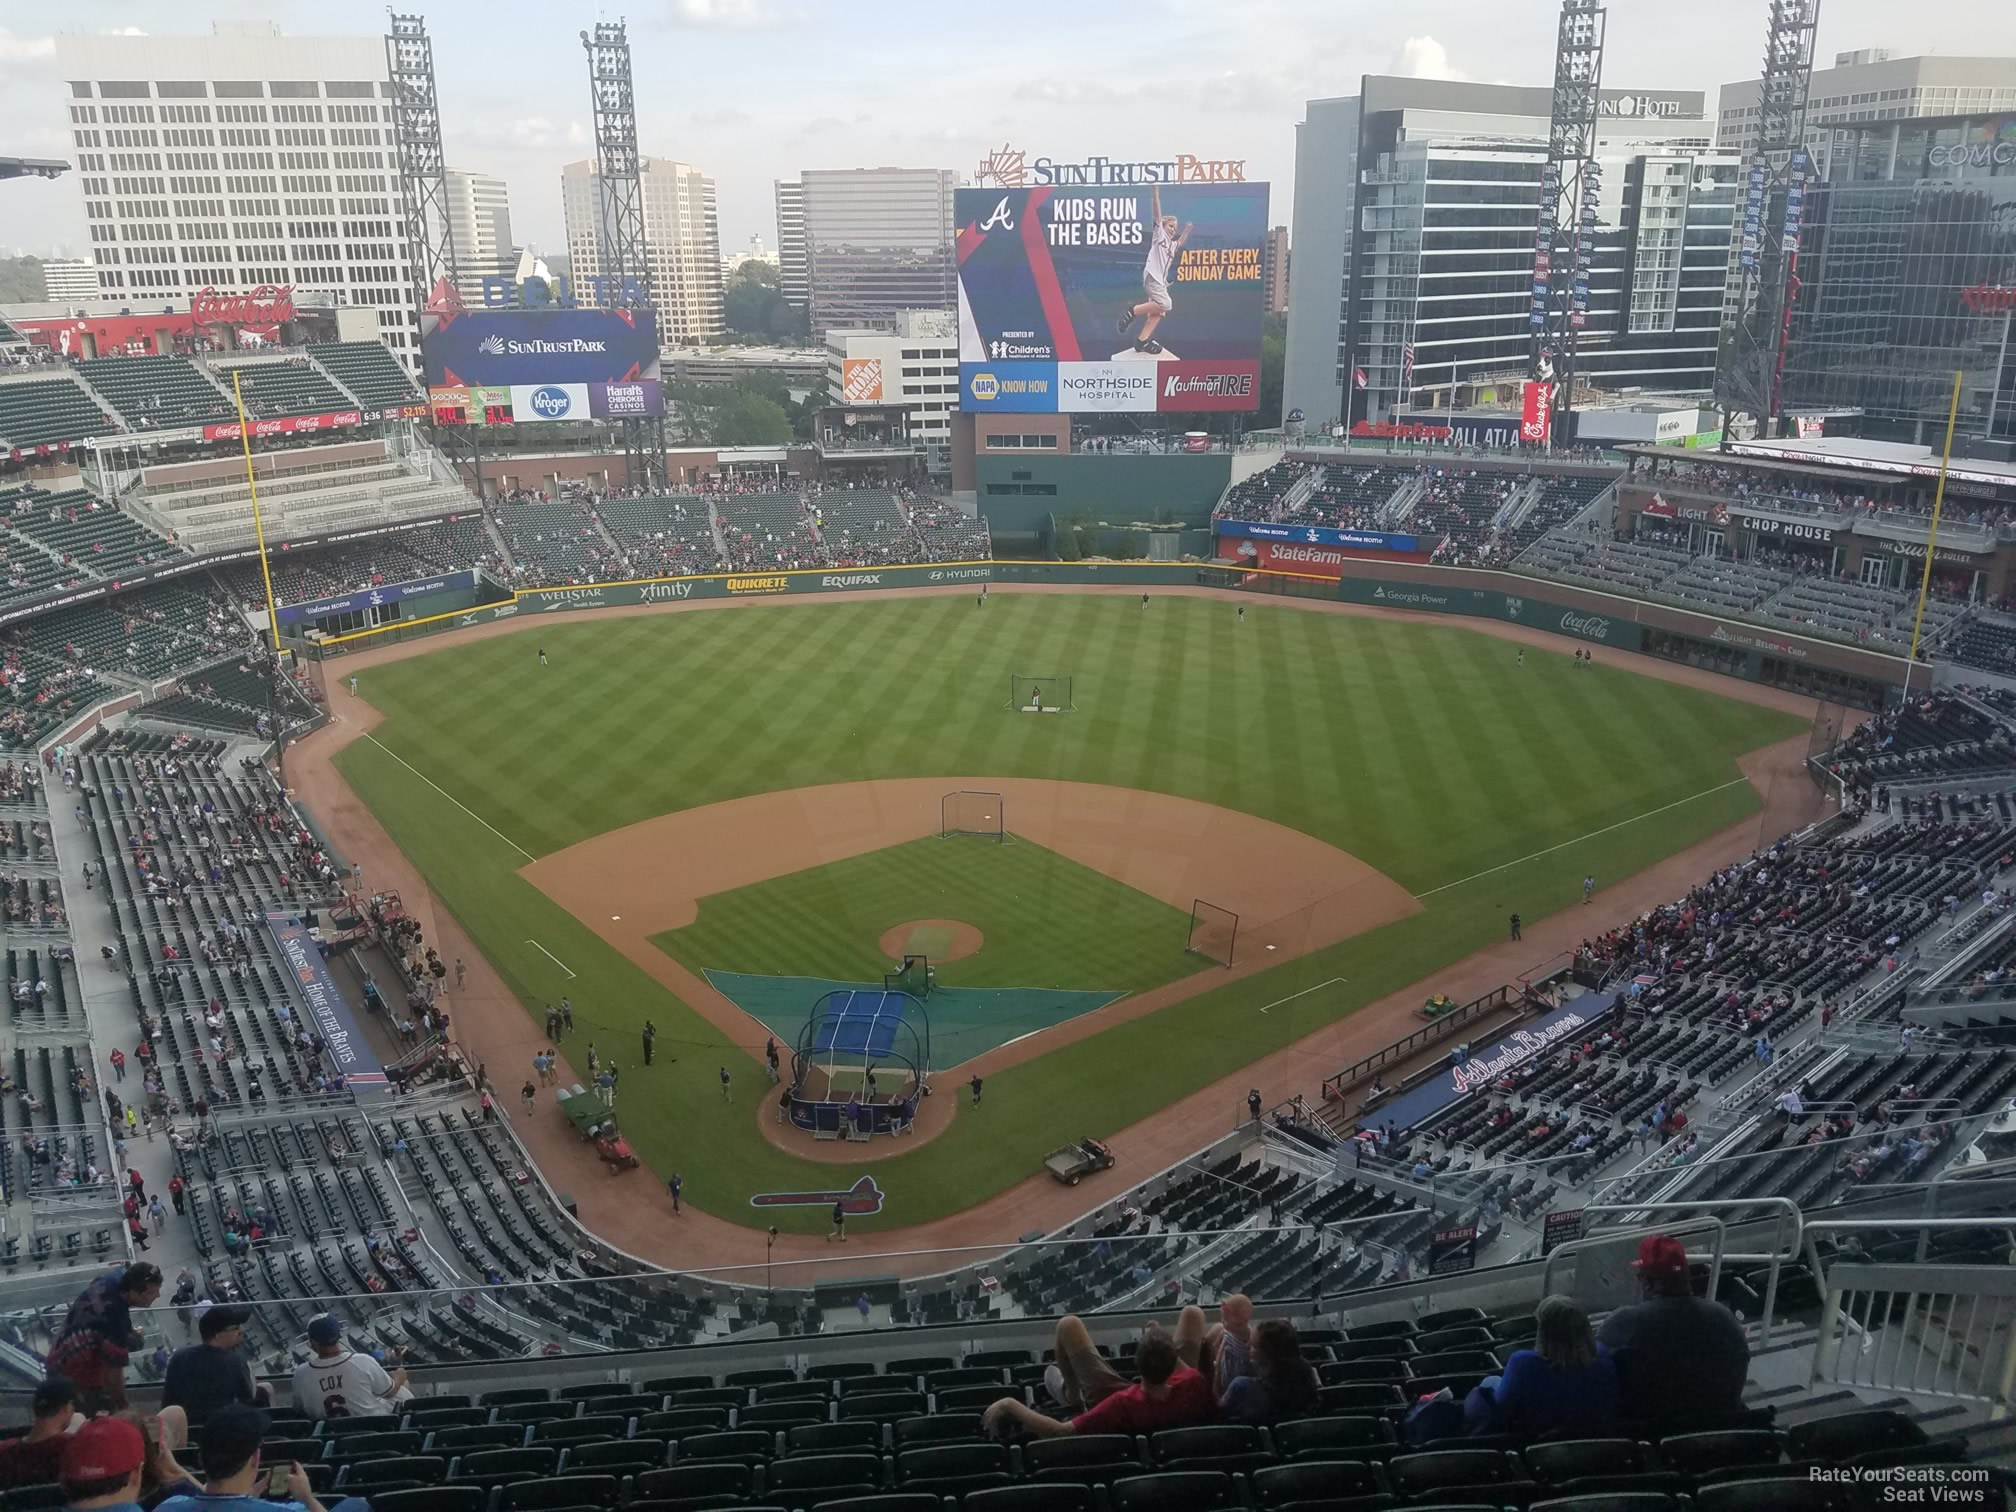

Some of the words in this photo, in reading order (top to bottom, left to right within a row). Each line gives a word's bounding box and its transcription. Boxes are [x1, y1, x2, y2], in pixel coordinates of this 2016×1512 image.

[1635, 97, 1680, 115] HOTEL
[1053, 198, 1095, 221] KIDS
[1100, 197, 1137, 220] RUN
[1048, 223, 1082, 246] THE
[1086, 222, 1143, 245] BASES
[1180, 249, 1218, 265] AFTER
[1221, 248, 1260, 264] EVERY
[1177, 265, 1224, 281] SUNDAY
[1227, 264, 1262, 280] GAME
[482, 276, 647, 306] DELTA
[1008, 345, 1051, 354] Children's
[844, 358, 882, 400] HOME
[846, 363, 864, 380] THE
[606, 385, 644, 397] Harrah's
[859, 373, 882, 400] DEPOT
[975, 380, 996, 393] NAPA
[1002, 380, 1026, 393] KNOW
[1028, 379, 1048, 392] HOW
[1063, 378, 1152, 389] NORTHSIDE
[1164, 376, 1220, 397] Kauffman
[1206, 374, 1253, 397] TIRE
[534, 391, 569, 415] Kroger
[1079, 391, 1136, 399] HOSPITAL
[364, 411, 381, 421] 6:36
[82, 436, 96, 449] 42
[1937, 470, 1962, 479] LGHT
[1677, 507, 1708, 520] LIGHT
[1742, 517, 1780, 533] CHOP
[1784, 524, 1832, 541] HOUSE
[1338, 533, 1362, 542] Welcome
[1879, 542, 1894, 550] THE
[1894, 540, 1942, 560] Silvr
[1943, 552, 1971, 563] BULLET
[822, 575, 881, 588] EQUIFAX
[946, 569, 991, 579] HYUNDAI
[402, 586, 425, 595] Welcome
[640, 581, 692, 599] xfinity
[726, 577, 788, 590] QUIKRETE
[540, 588, 602, 601] WELLSTAR
[1387, 590, 1419, 603] Georgia
[1421, 593, 1447, 605] Power
[305, 604, 330, 614] Welcome
[1560, 611, 1611, 638] Coca-Cola
[305, 982, 324, 1008] HOME
[317, 1006, 333, 1020] OF
[322, 1017, 341, 1033] THE
[330, 1030, 356, 1064] BRAVES
[1452, 1045, 1527, 1093] Atlanta
[1511, 1012, 1585, 1053] Braves
[1435, 1232, 1448, 1242] BE
[1448, 1228, 1474, 1239] ALERT
[319, 1375, 343, 1392] COX
[323, 1394, 351, 1419] 6
